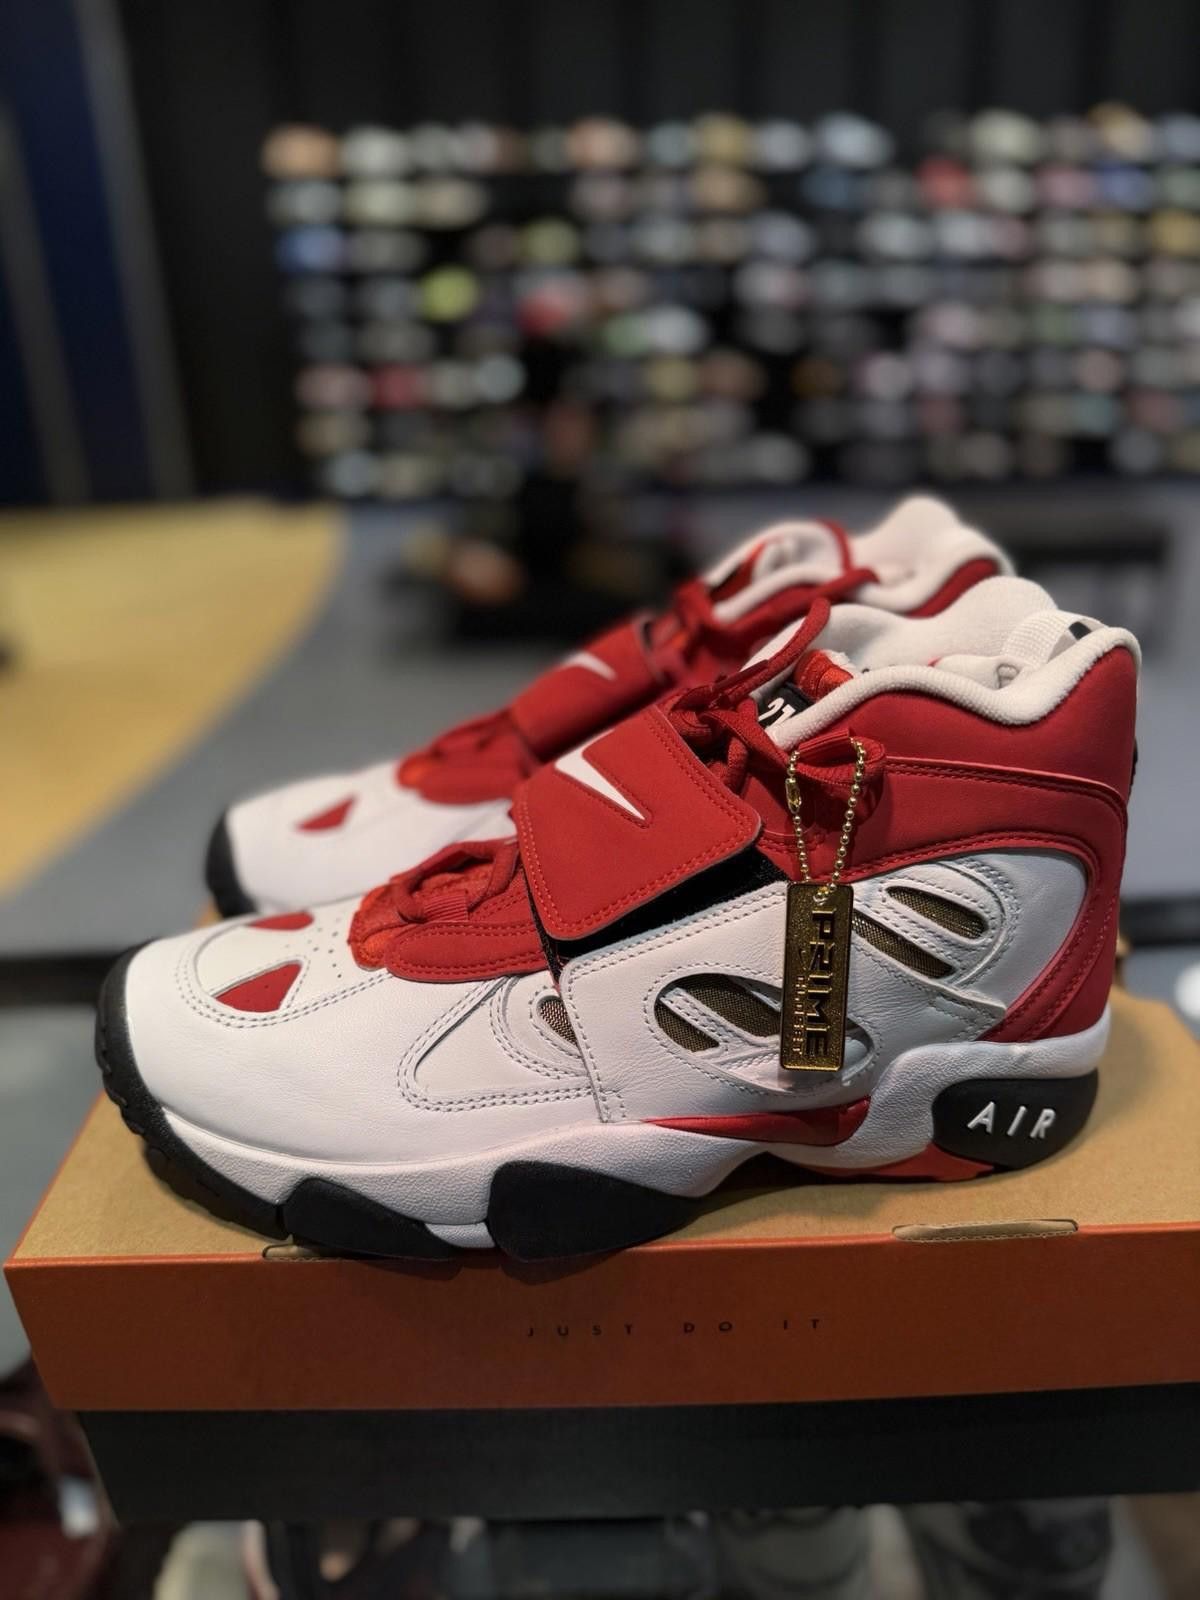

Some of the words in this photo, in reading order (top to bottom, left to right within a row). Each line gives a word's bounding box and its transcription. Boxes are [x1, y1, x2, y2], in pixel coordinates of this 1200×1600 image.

[805, 908, 837, 1056] PRIME
[967, 1101, 1056, 1139] AIR
[527, 1323, 633, 1338] JUST
[682, 1321, 733, 1335] DO
[782, 1318, 820, 1331] IT
